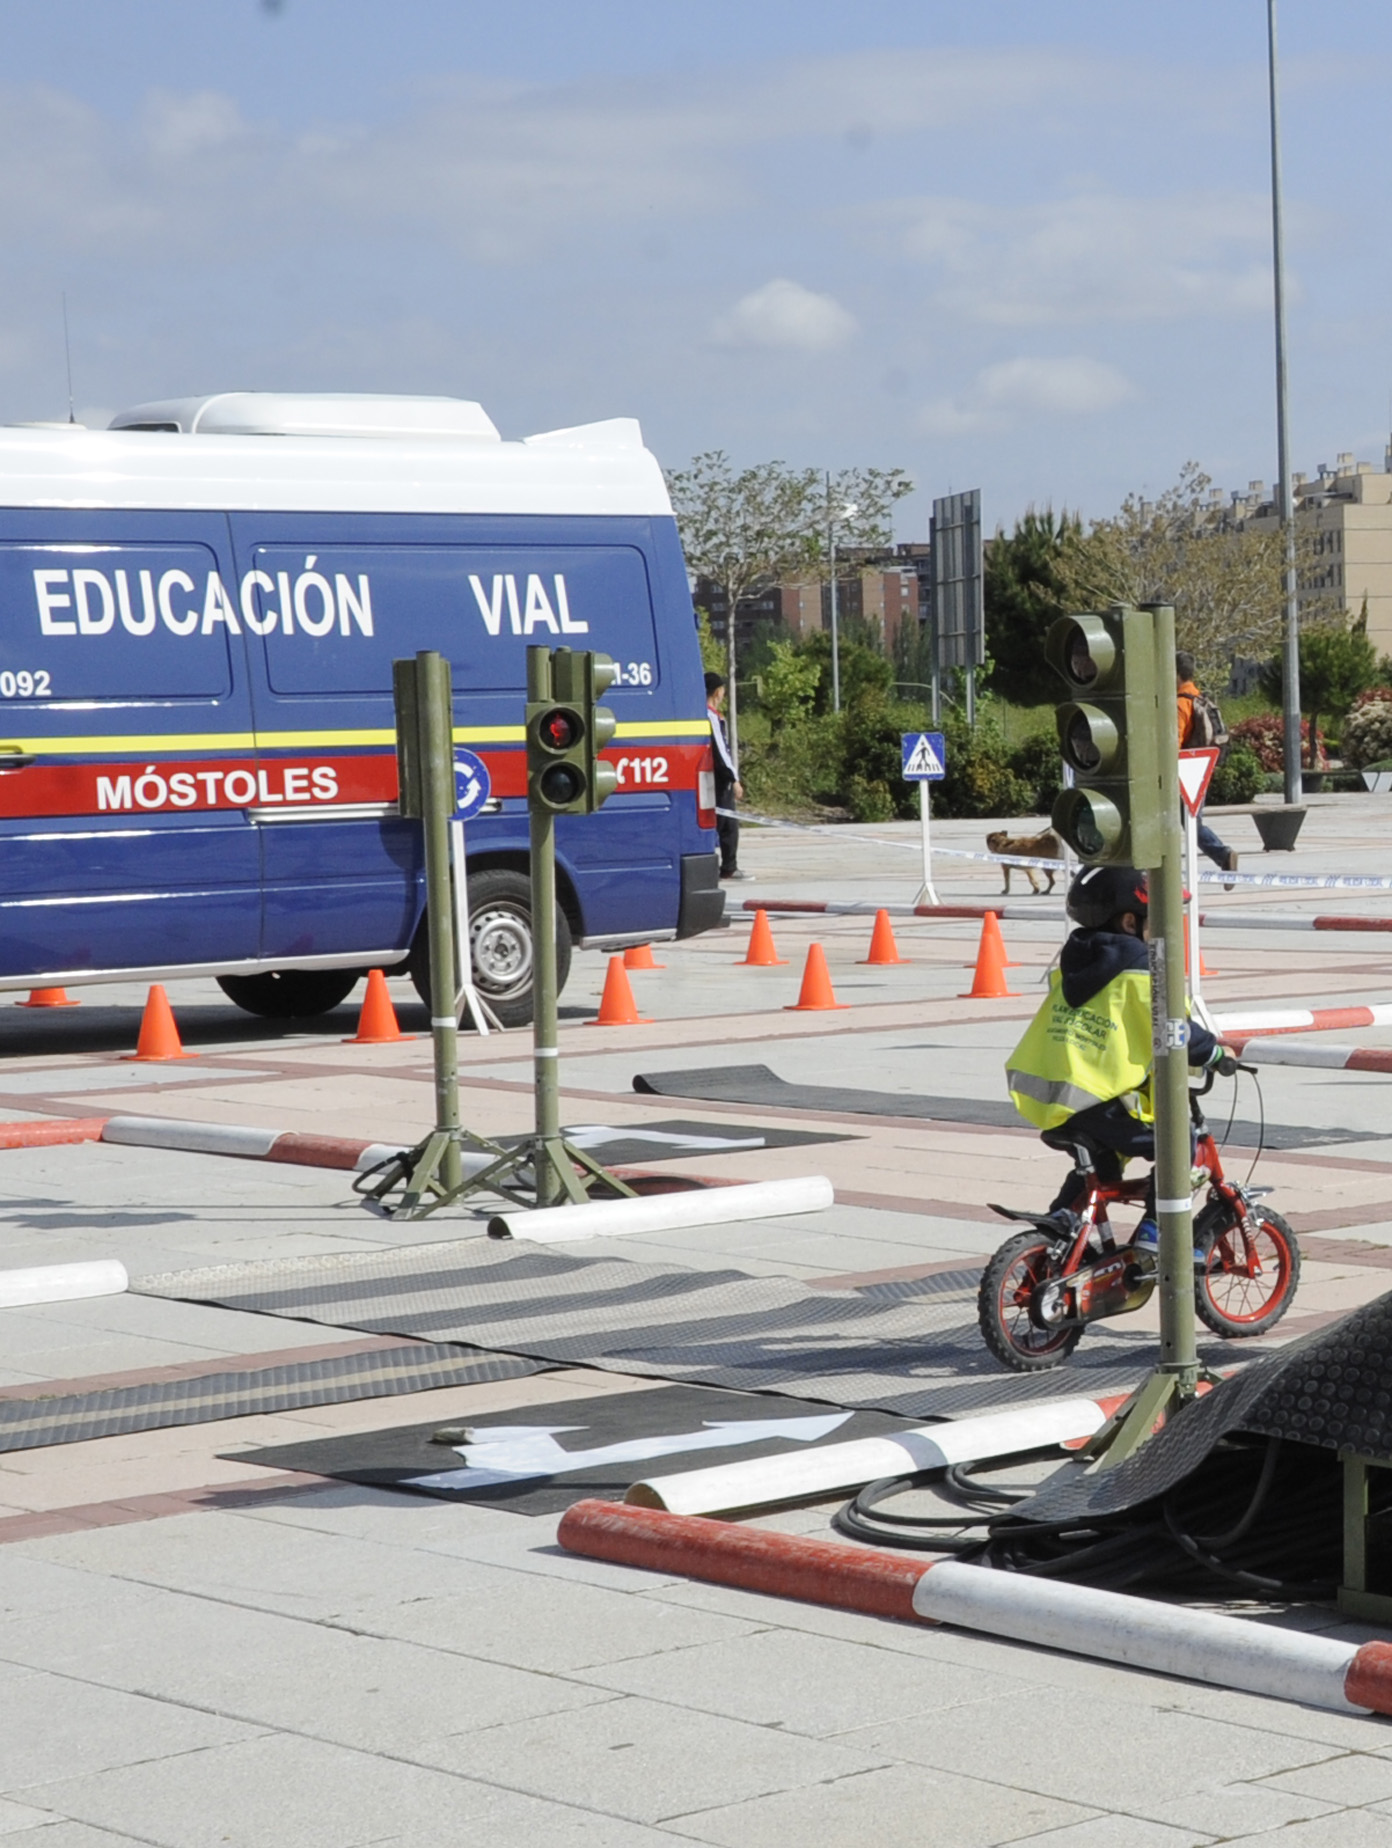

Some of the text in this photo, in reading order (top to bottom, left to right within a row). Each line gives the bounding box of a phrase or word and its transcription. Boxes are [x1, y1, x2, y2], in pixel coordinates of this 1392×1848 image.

[33, 555, 589, 637] EDUCACIÓN VIAL
[0, 670, 52, 697] 092
[96, 765, 339, 810] MÓSTOLES
[629, 757, 669, 783] 112
